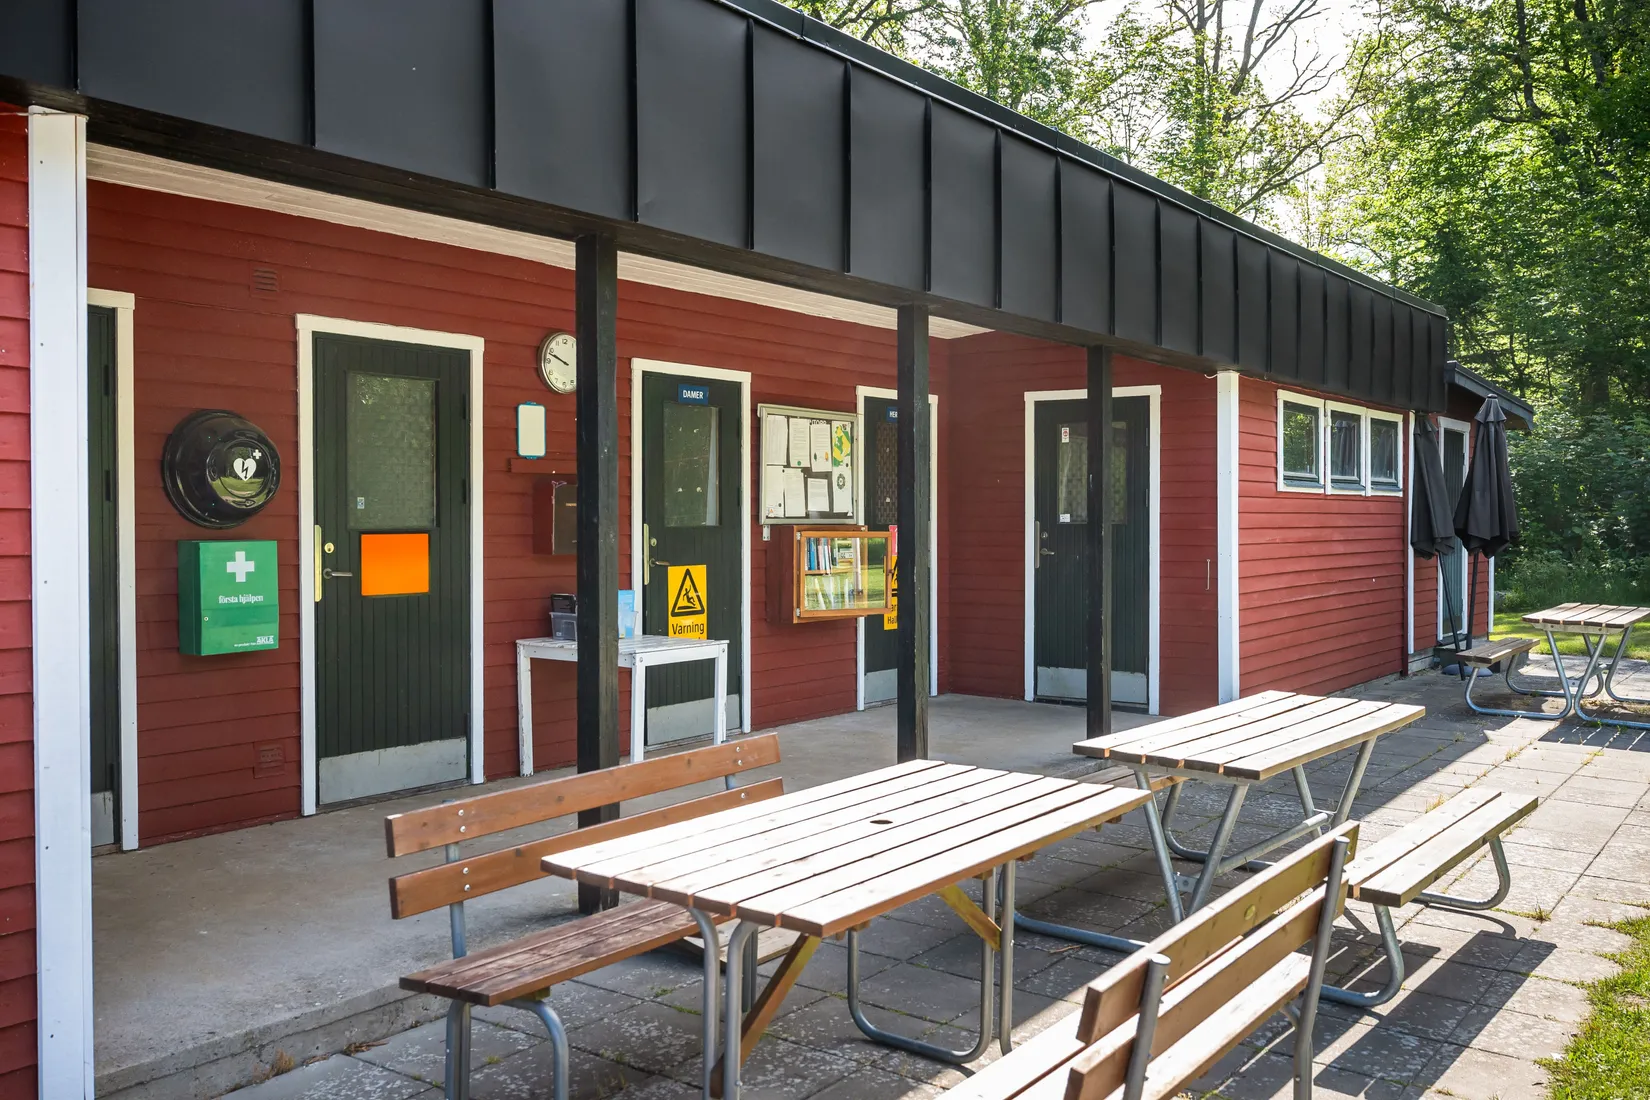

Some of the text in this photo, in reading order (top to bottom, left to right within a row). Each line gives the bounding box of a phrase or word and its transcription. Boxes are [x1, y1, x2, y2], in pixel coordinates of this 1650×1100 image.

[682, 390, 704, 399] DAMER
[890, 410, 898, 418] HER
[219, 594, 264, 604] första hjälpen
[672, 622, 705, 635] Varning
